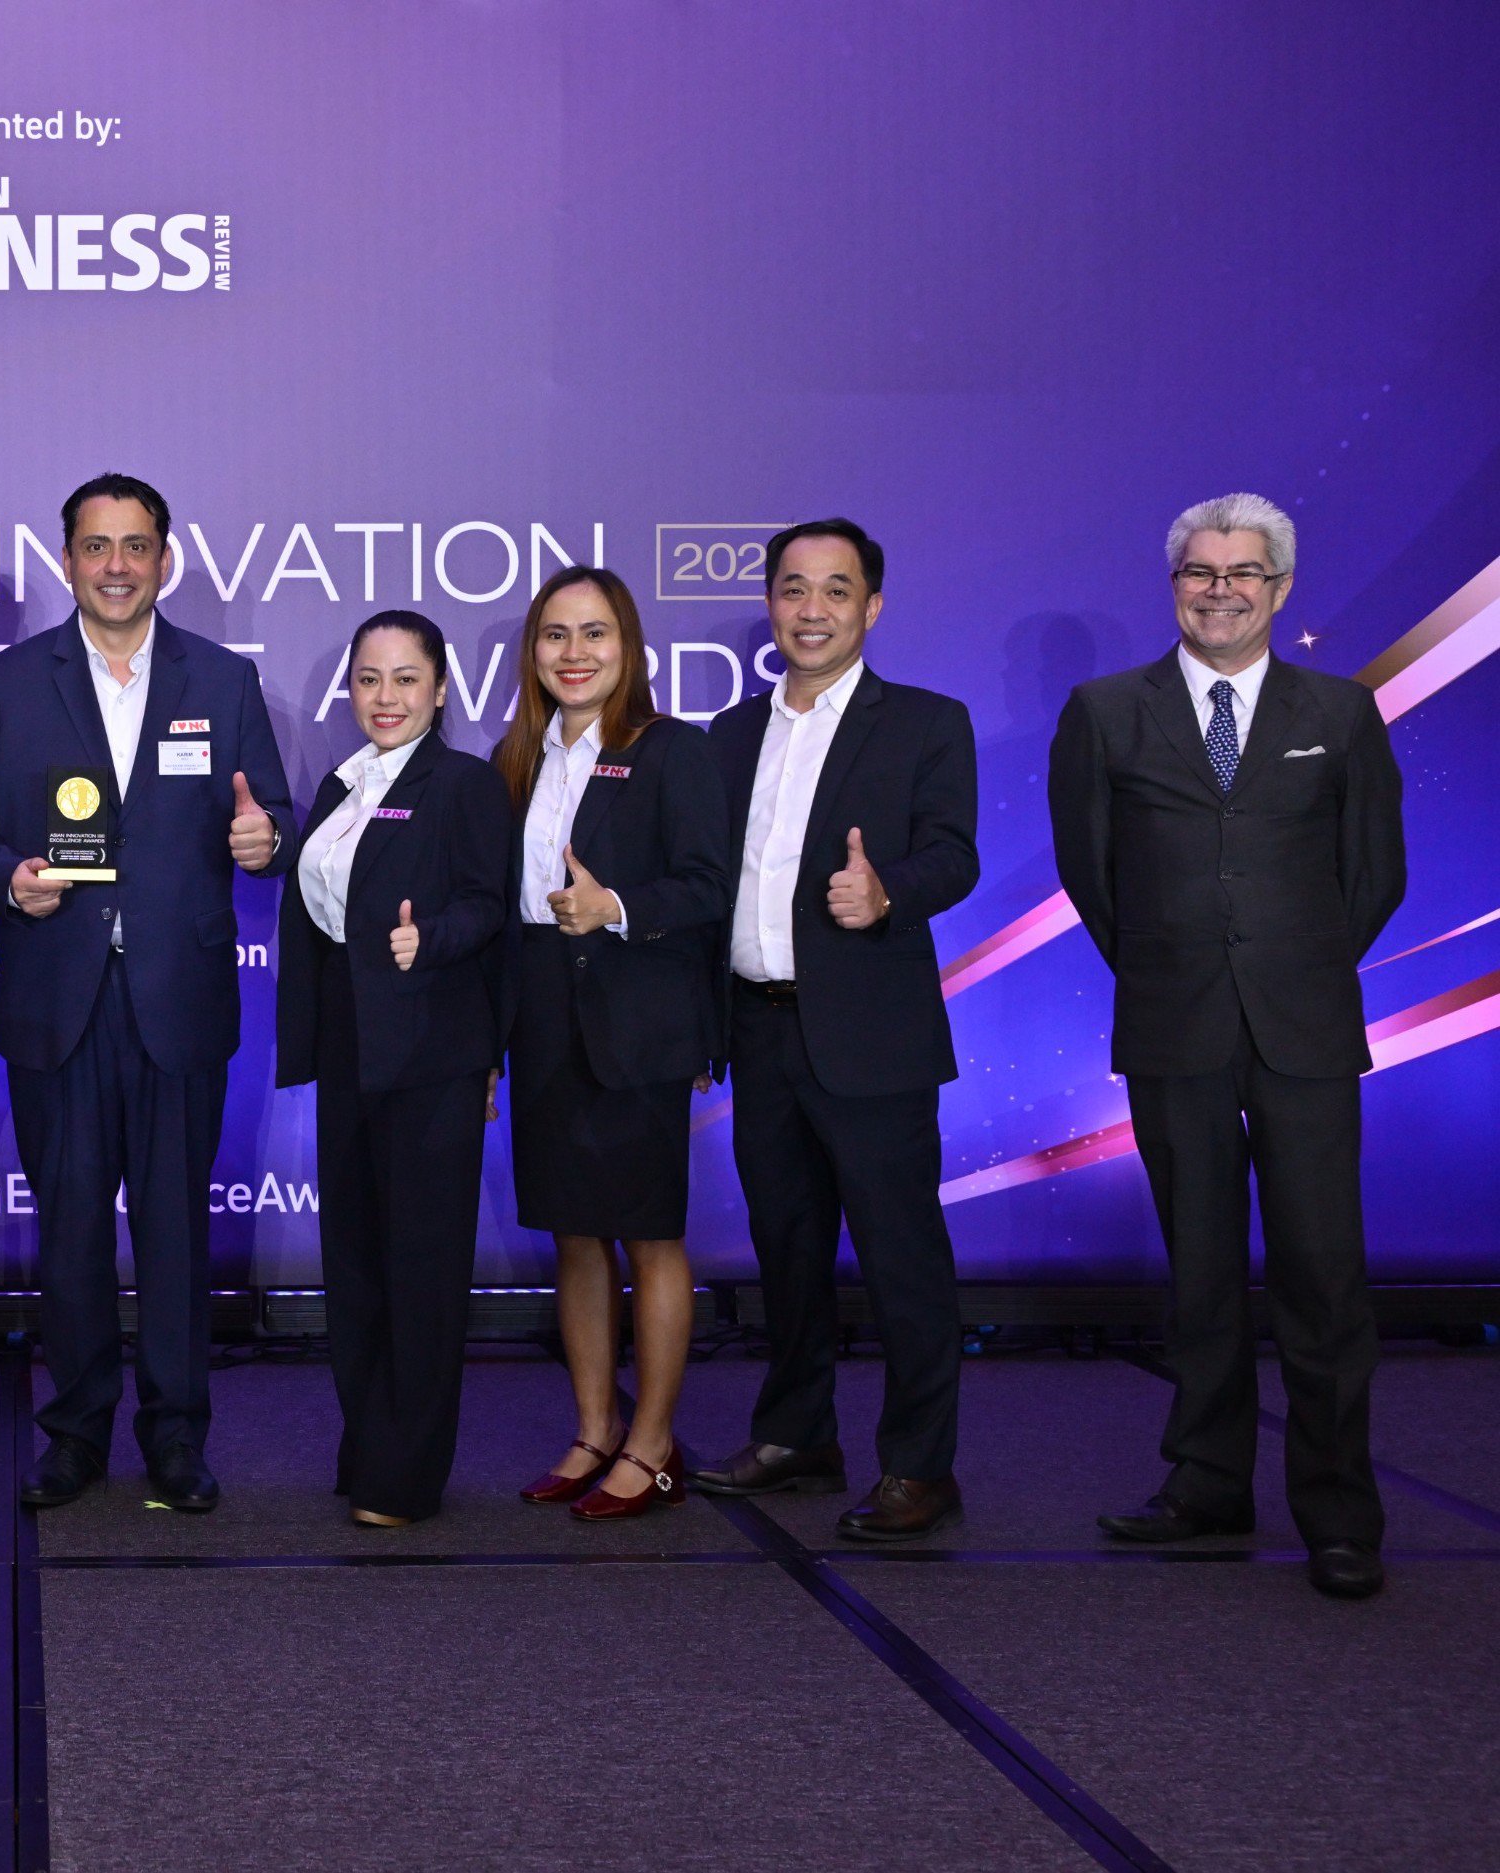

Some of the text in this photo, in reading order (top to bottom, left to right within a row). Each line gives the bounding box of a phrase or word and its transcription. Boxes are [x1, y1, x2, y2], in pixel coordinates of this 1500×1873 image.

[75, 110, 122, 147] by:
[214, 215, 231, 291] REVIEW
[673, 542, 767, 582] 202
